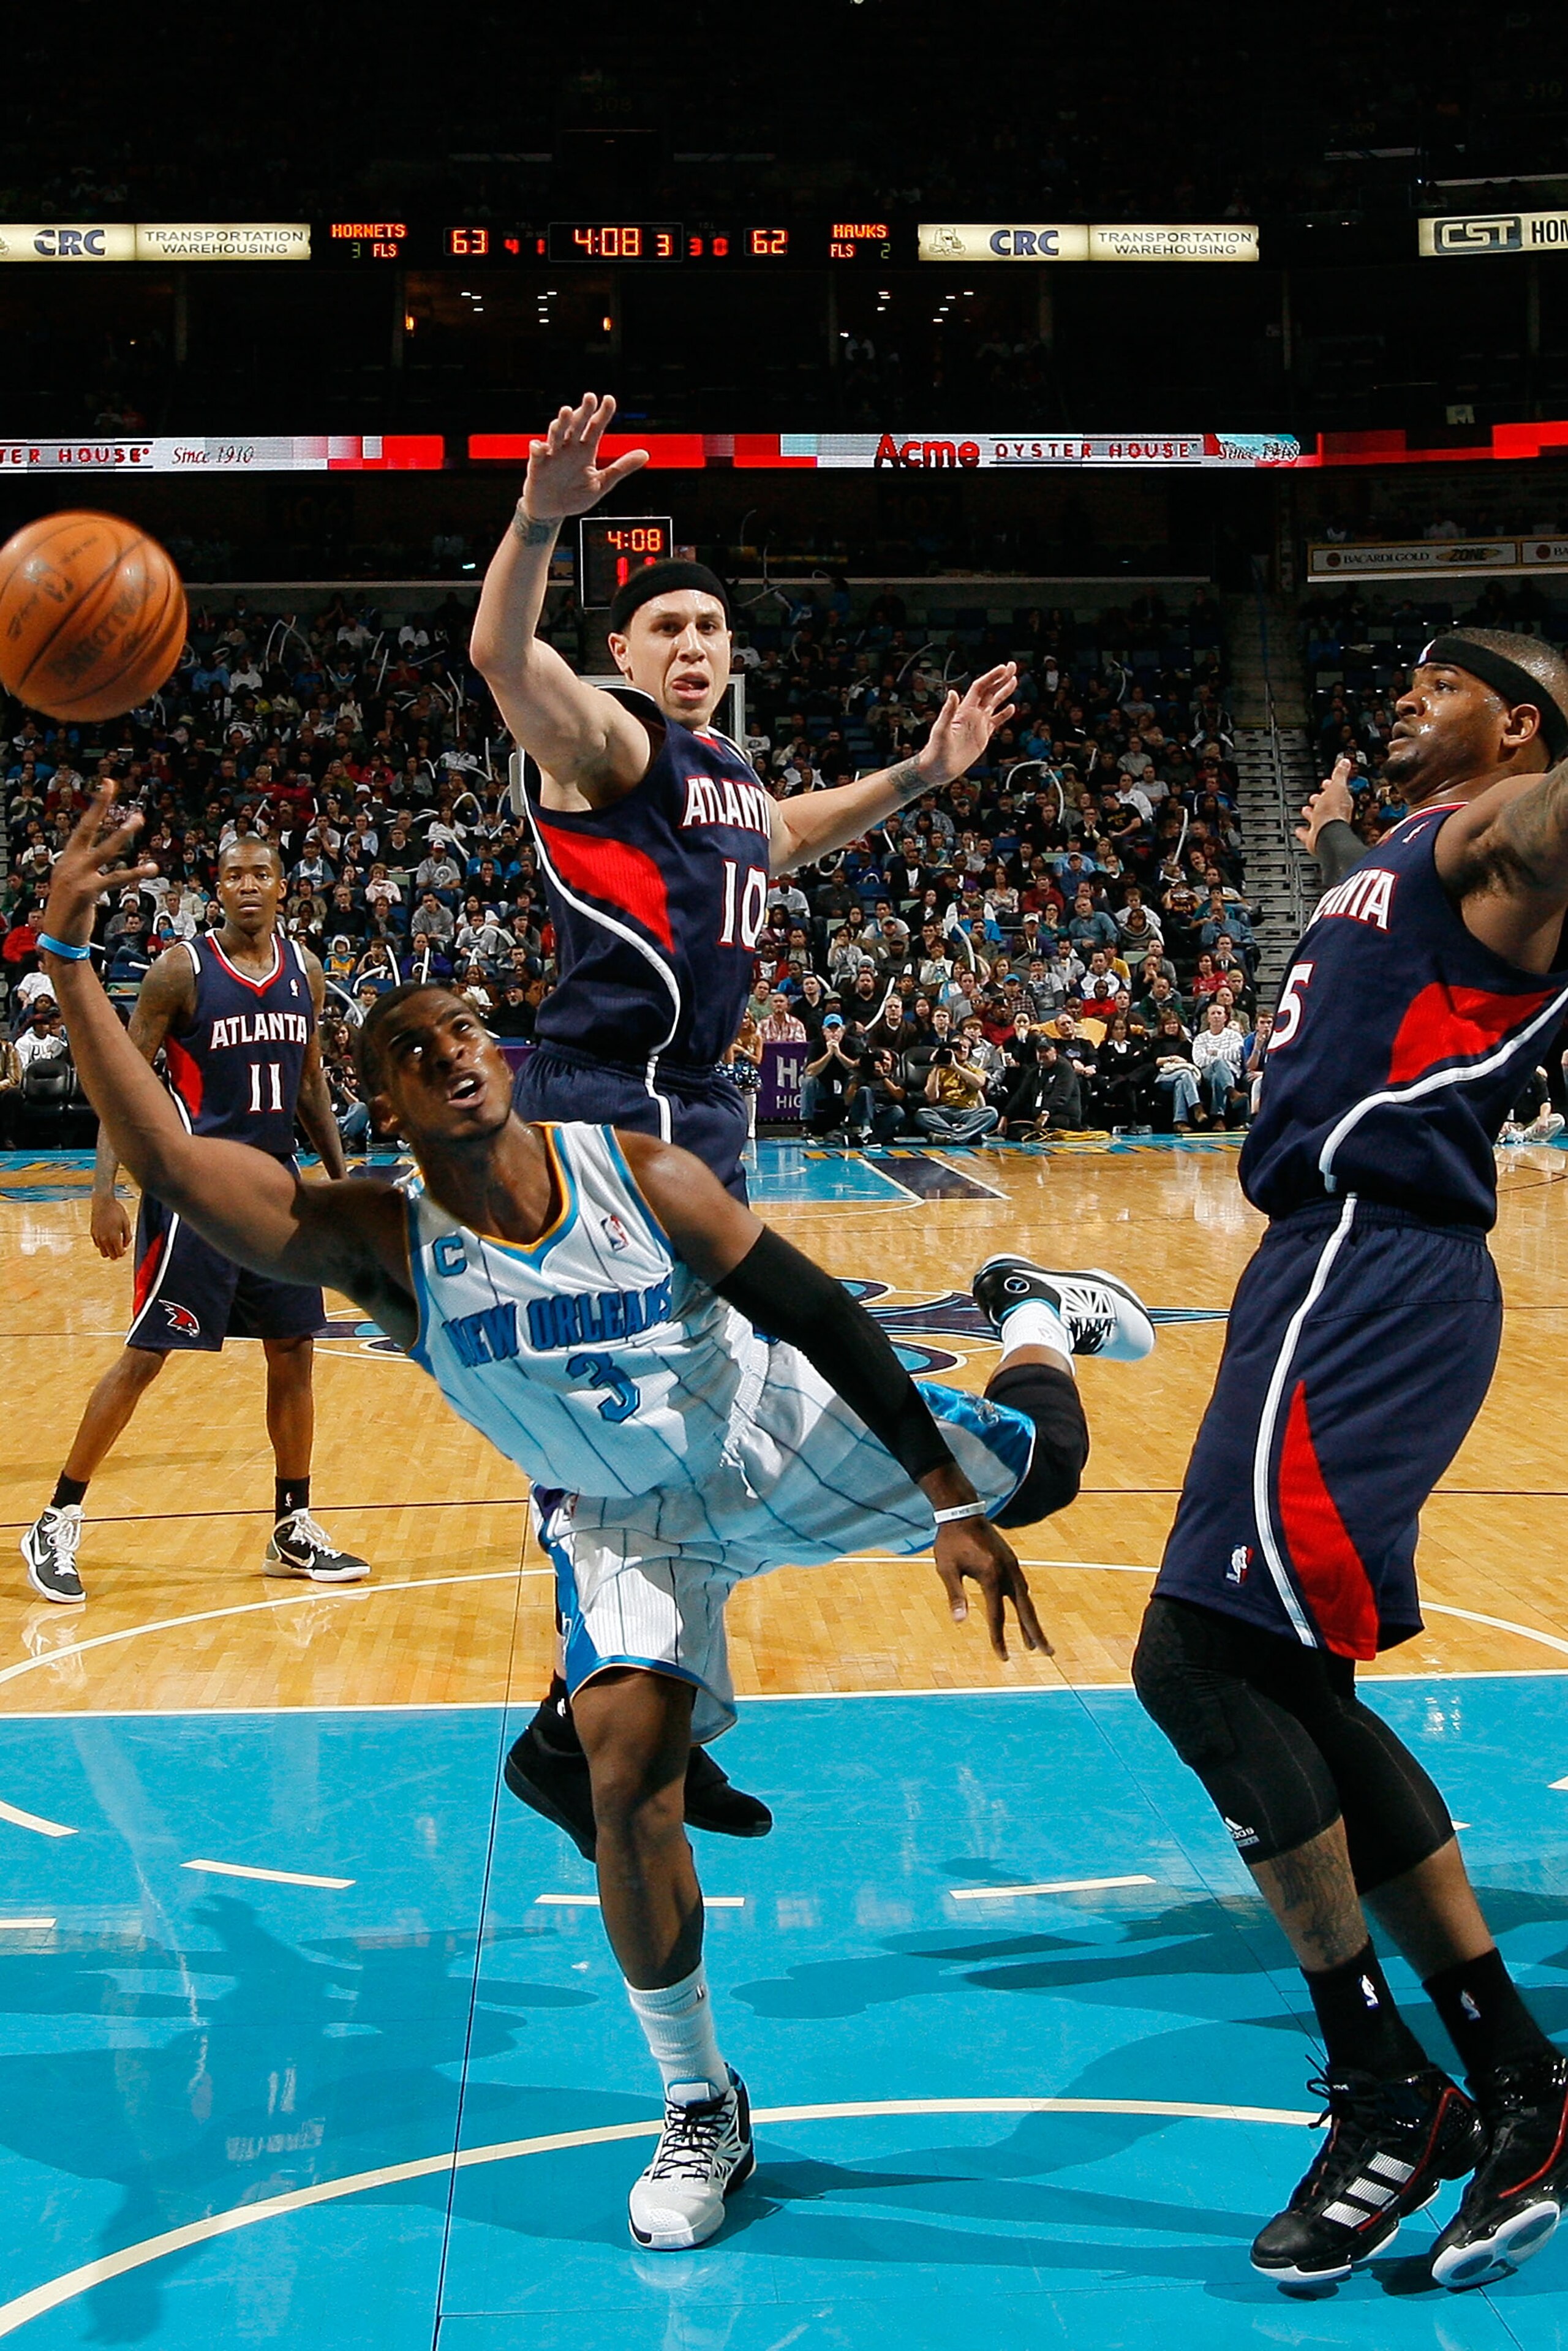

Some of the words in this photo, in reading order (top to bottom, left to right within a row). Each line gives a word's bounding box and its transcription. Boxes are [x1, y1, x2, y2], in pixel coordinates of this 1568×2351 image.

[33, 229, 106, 255] CRC
[145, 230, 304, 243] TRANSPORTATION
[331, 224, 407, 238] HORNETS
[452, 229, 488, 255] 63
[574, 228, 642, 256] 4:08
[657, 234, 671, 256] 3
[753, 229, 788, 255] 62
[832, 224, 888, 238] HAWKS
[990, 229, 1060, 256] CRC
[1098, 231, 1253, 243] TRANSPORTATION
[1441, 221, 1515, 248] CST
[162, 243, 288, 255] WAREHOUSING
[372, 243, 398, 258] FLS
[689, 239, 703, 256] 3
[831, 244, 854, 257] FLS
[880, 243, 890, 258] 2
[1115, 244, 1237, 255] WAREHOUSING
[874, 434, 979, 468] Acme
[995, 443, 1091, 459] OYSTER
[607, 529, 662, 551] 4:08
[1344, 554, 1394, 564] BACARDI
[1396, 552, 1430, 563] GOLD
[1450, 548, 1490, 562] ZONE
[717, 858, 767, 951] 10
[1266, 960, 1316, 1052] 5
[209, 1011, 307, 1050] ATLANTA
[247, 1062, 284, 1113] 11
[432, 1235, 467, 1278] C
[442, 1300, 519, 1368] NEW
[526, 1274, 673, 1350] ORLEANS
[565, 1351, 641, 1423] 3
